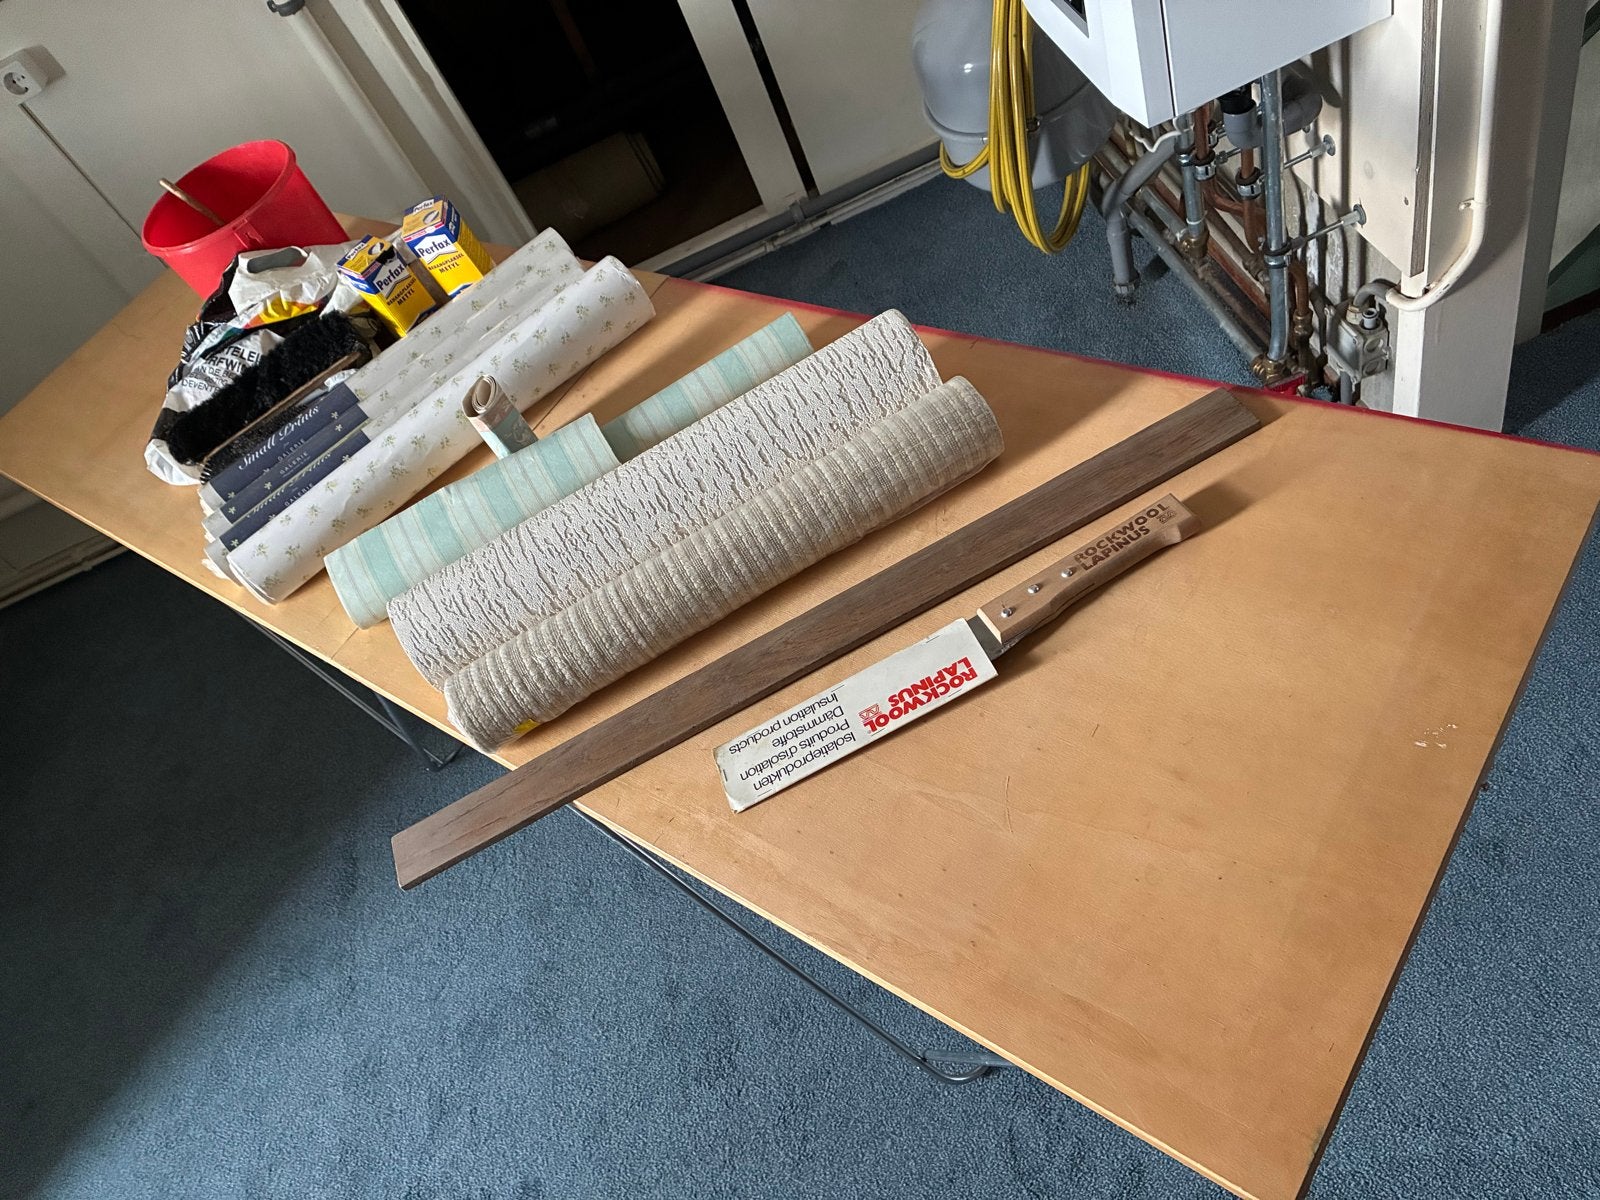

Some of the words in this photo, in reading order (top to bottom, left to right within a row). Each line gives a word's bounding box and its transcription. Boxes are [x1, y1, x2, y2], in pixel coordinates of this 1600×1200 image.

[417, 238, 452, 257] Perfax
[376, 263, 406, 291] Perfax
[438, 262, 460, 273] METYL
[397, 288, 416, 306] METYL
[238, 440, 276, 471] Small
[278, 405, 320, 441] Prints
[277, 438, 306, 463] GALERIE
[279, 451, 309, 475] GALERIE
[1074, 503, 1170, 563] ROCKWOOL
[1081, 525, 1151, 572] LAPINUS
[888, 656, 971, 708] LAPINUS
[783, 692, 839, 727] Insulation
[862, 667, 978, 733] ROCKWOOL
[728, 722, 782, 756] products
[771, 704, 845, 749] Dämmstoffe
[798, 719, 851, 751] Produits
[739, 744, 799, 782] d'isolation
[753, 731, 856, 792] Isolatieprodukten
